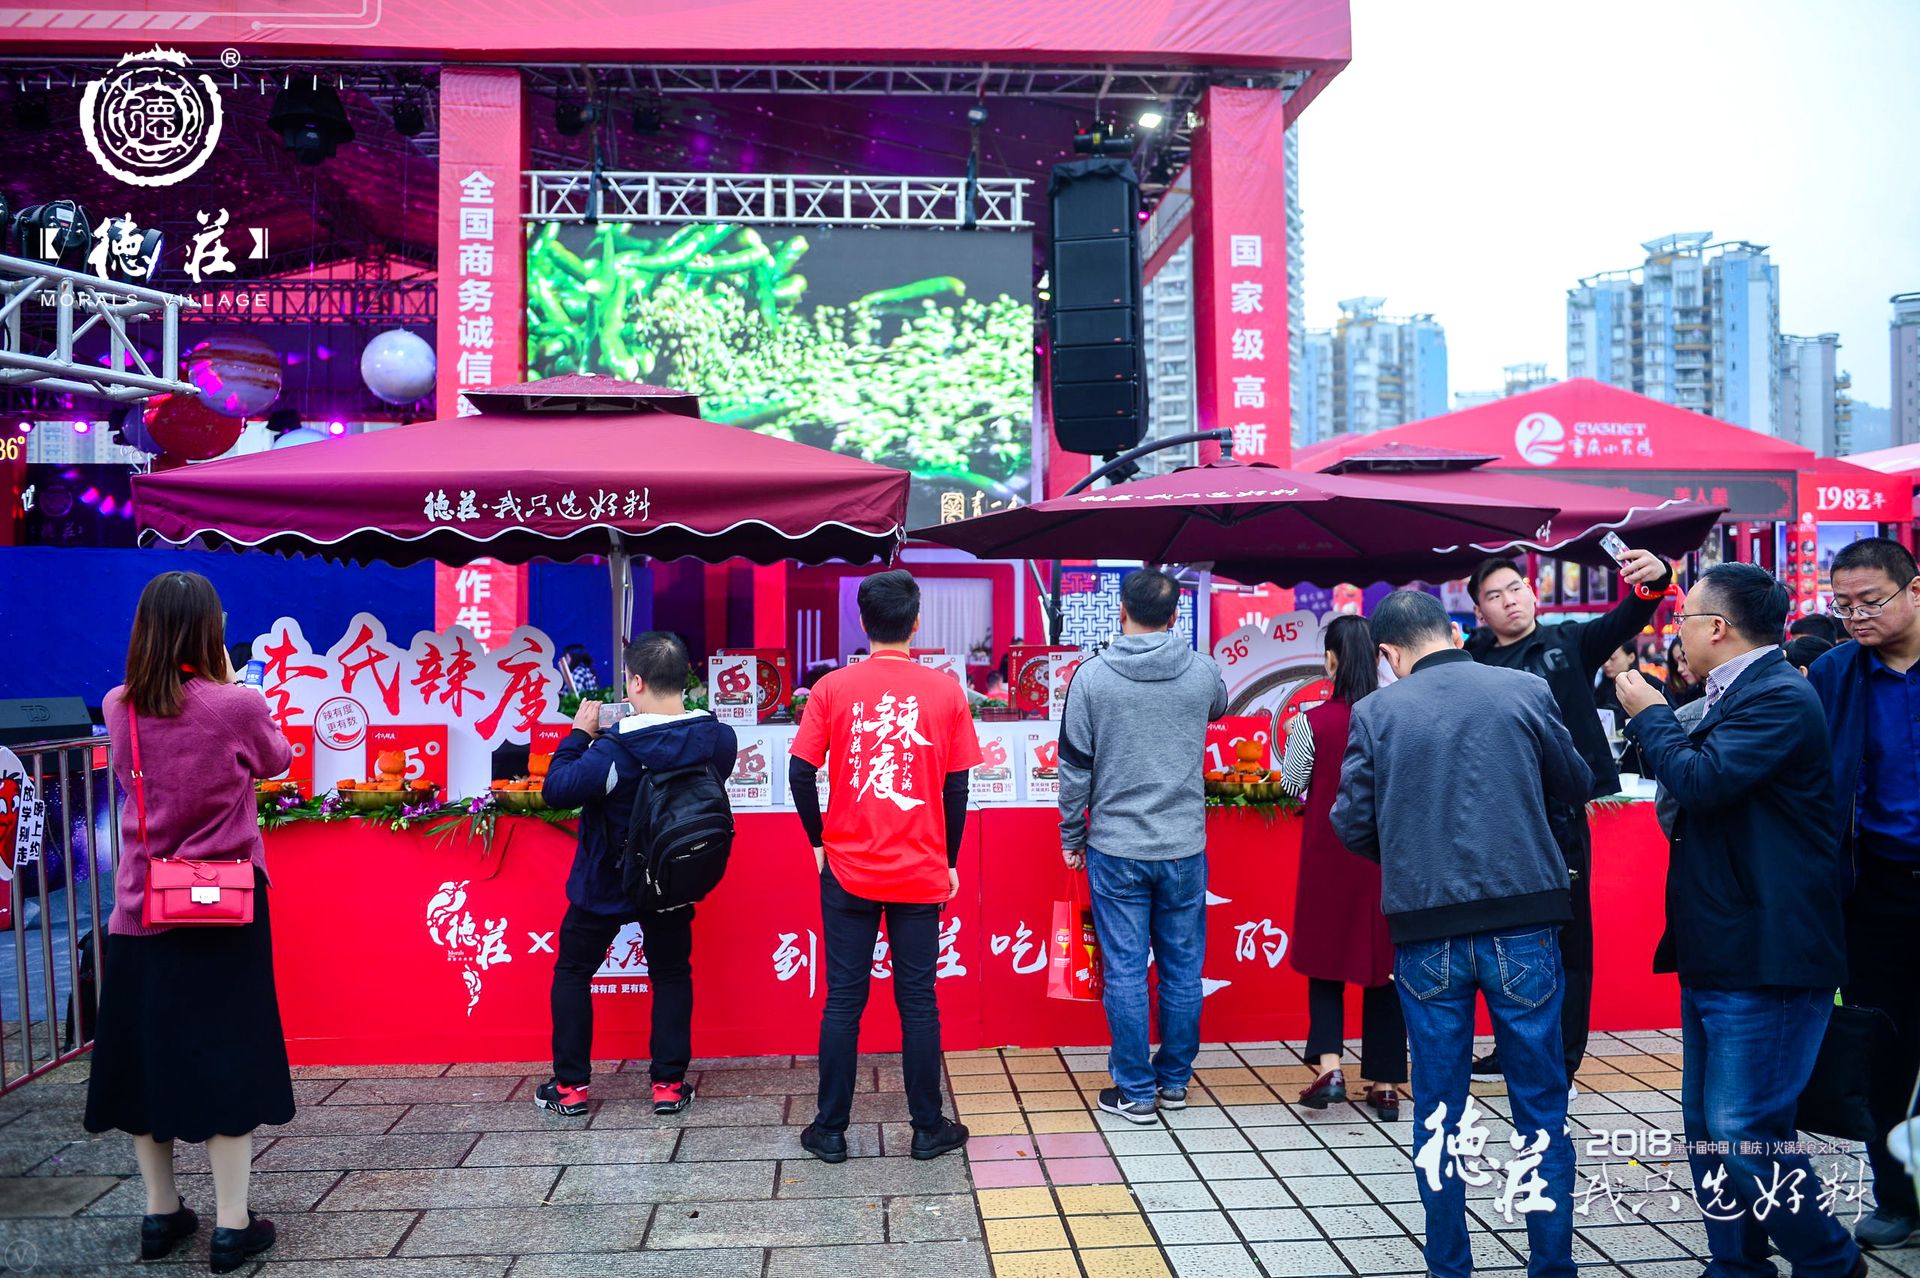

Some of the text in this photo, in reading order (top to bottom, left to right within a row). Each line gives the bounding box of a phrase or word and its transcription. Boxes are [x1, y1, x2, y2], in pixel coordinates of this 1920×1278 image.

[1221, 620, 1304, 666] 36° 45°
[17, 784, 35, 864] 放学别走
[30, 800, 45, 858] 晚上约
[621, 984, 648, 993] 更有数
